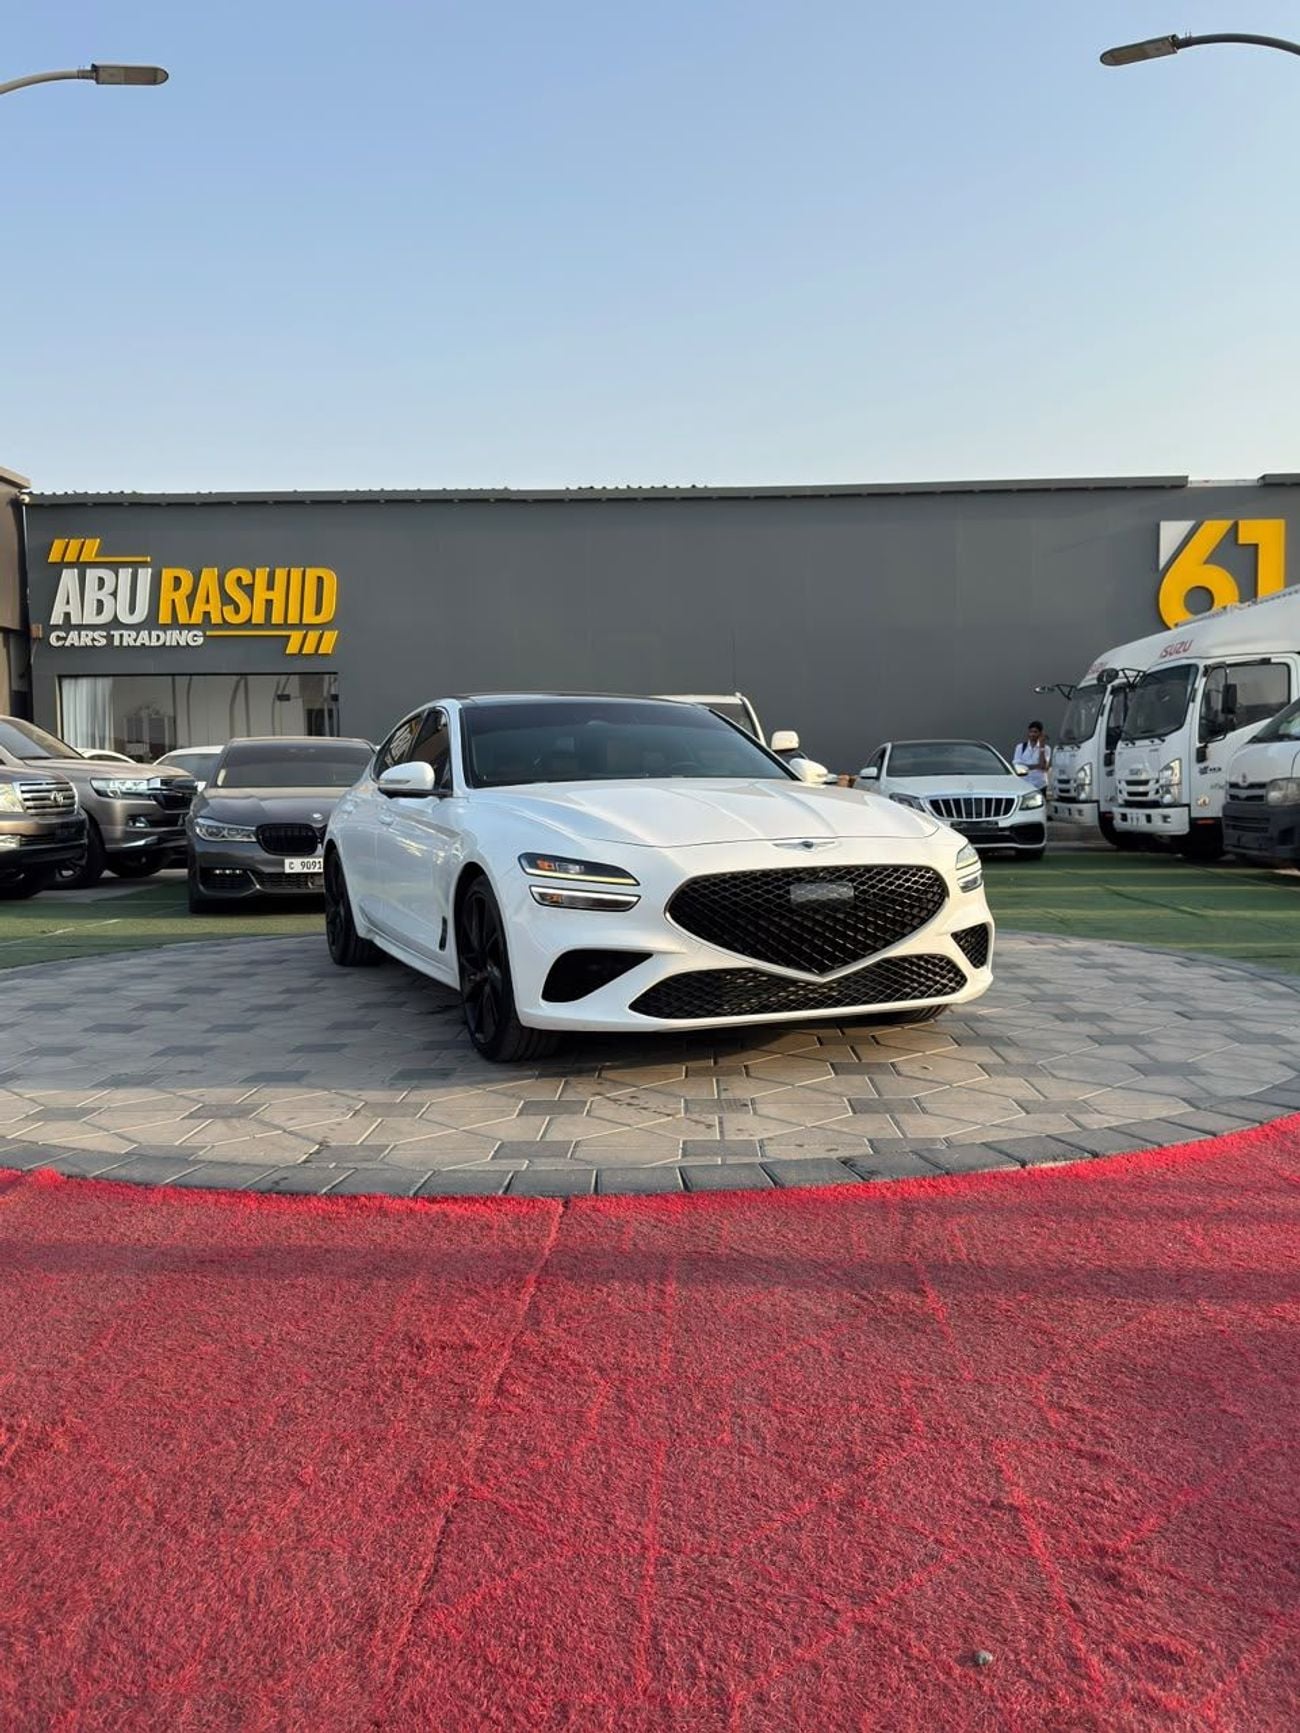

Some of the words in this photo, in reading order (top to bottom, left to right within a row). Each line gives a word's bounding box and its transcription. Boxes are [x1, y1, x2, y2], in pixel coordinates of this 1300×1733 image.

[50, 567, 151, 625] ABU
[158, 567, 338, 625] RASHID
[1159, 519, 1285, 630] 61
[49, 631, 107, 647] CARS
[112, 630, 204, 647] TRADING
